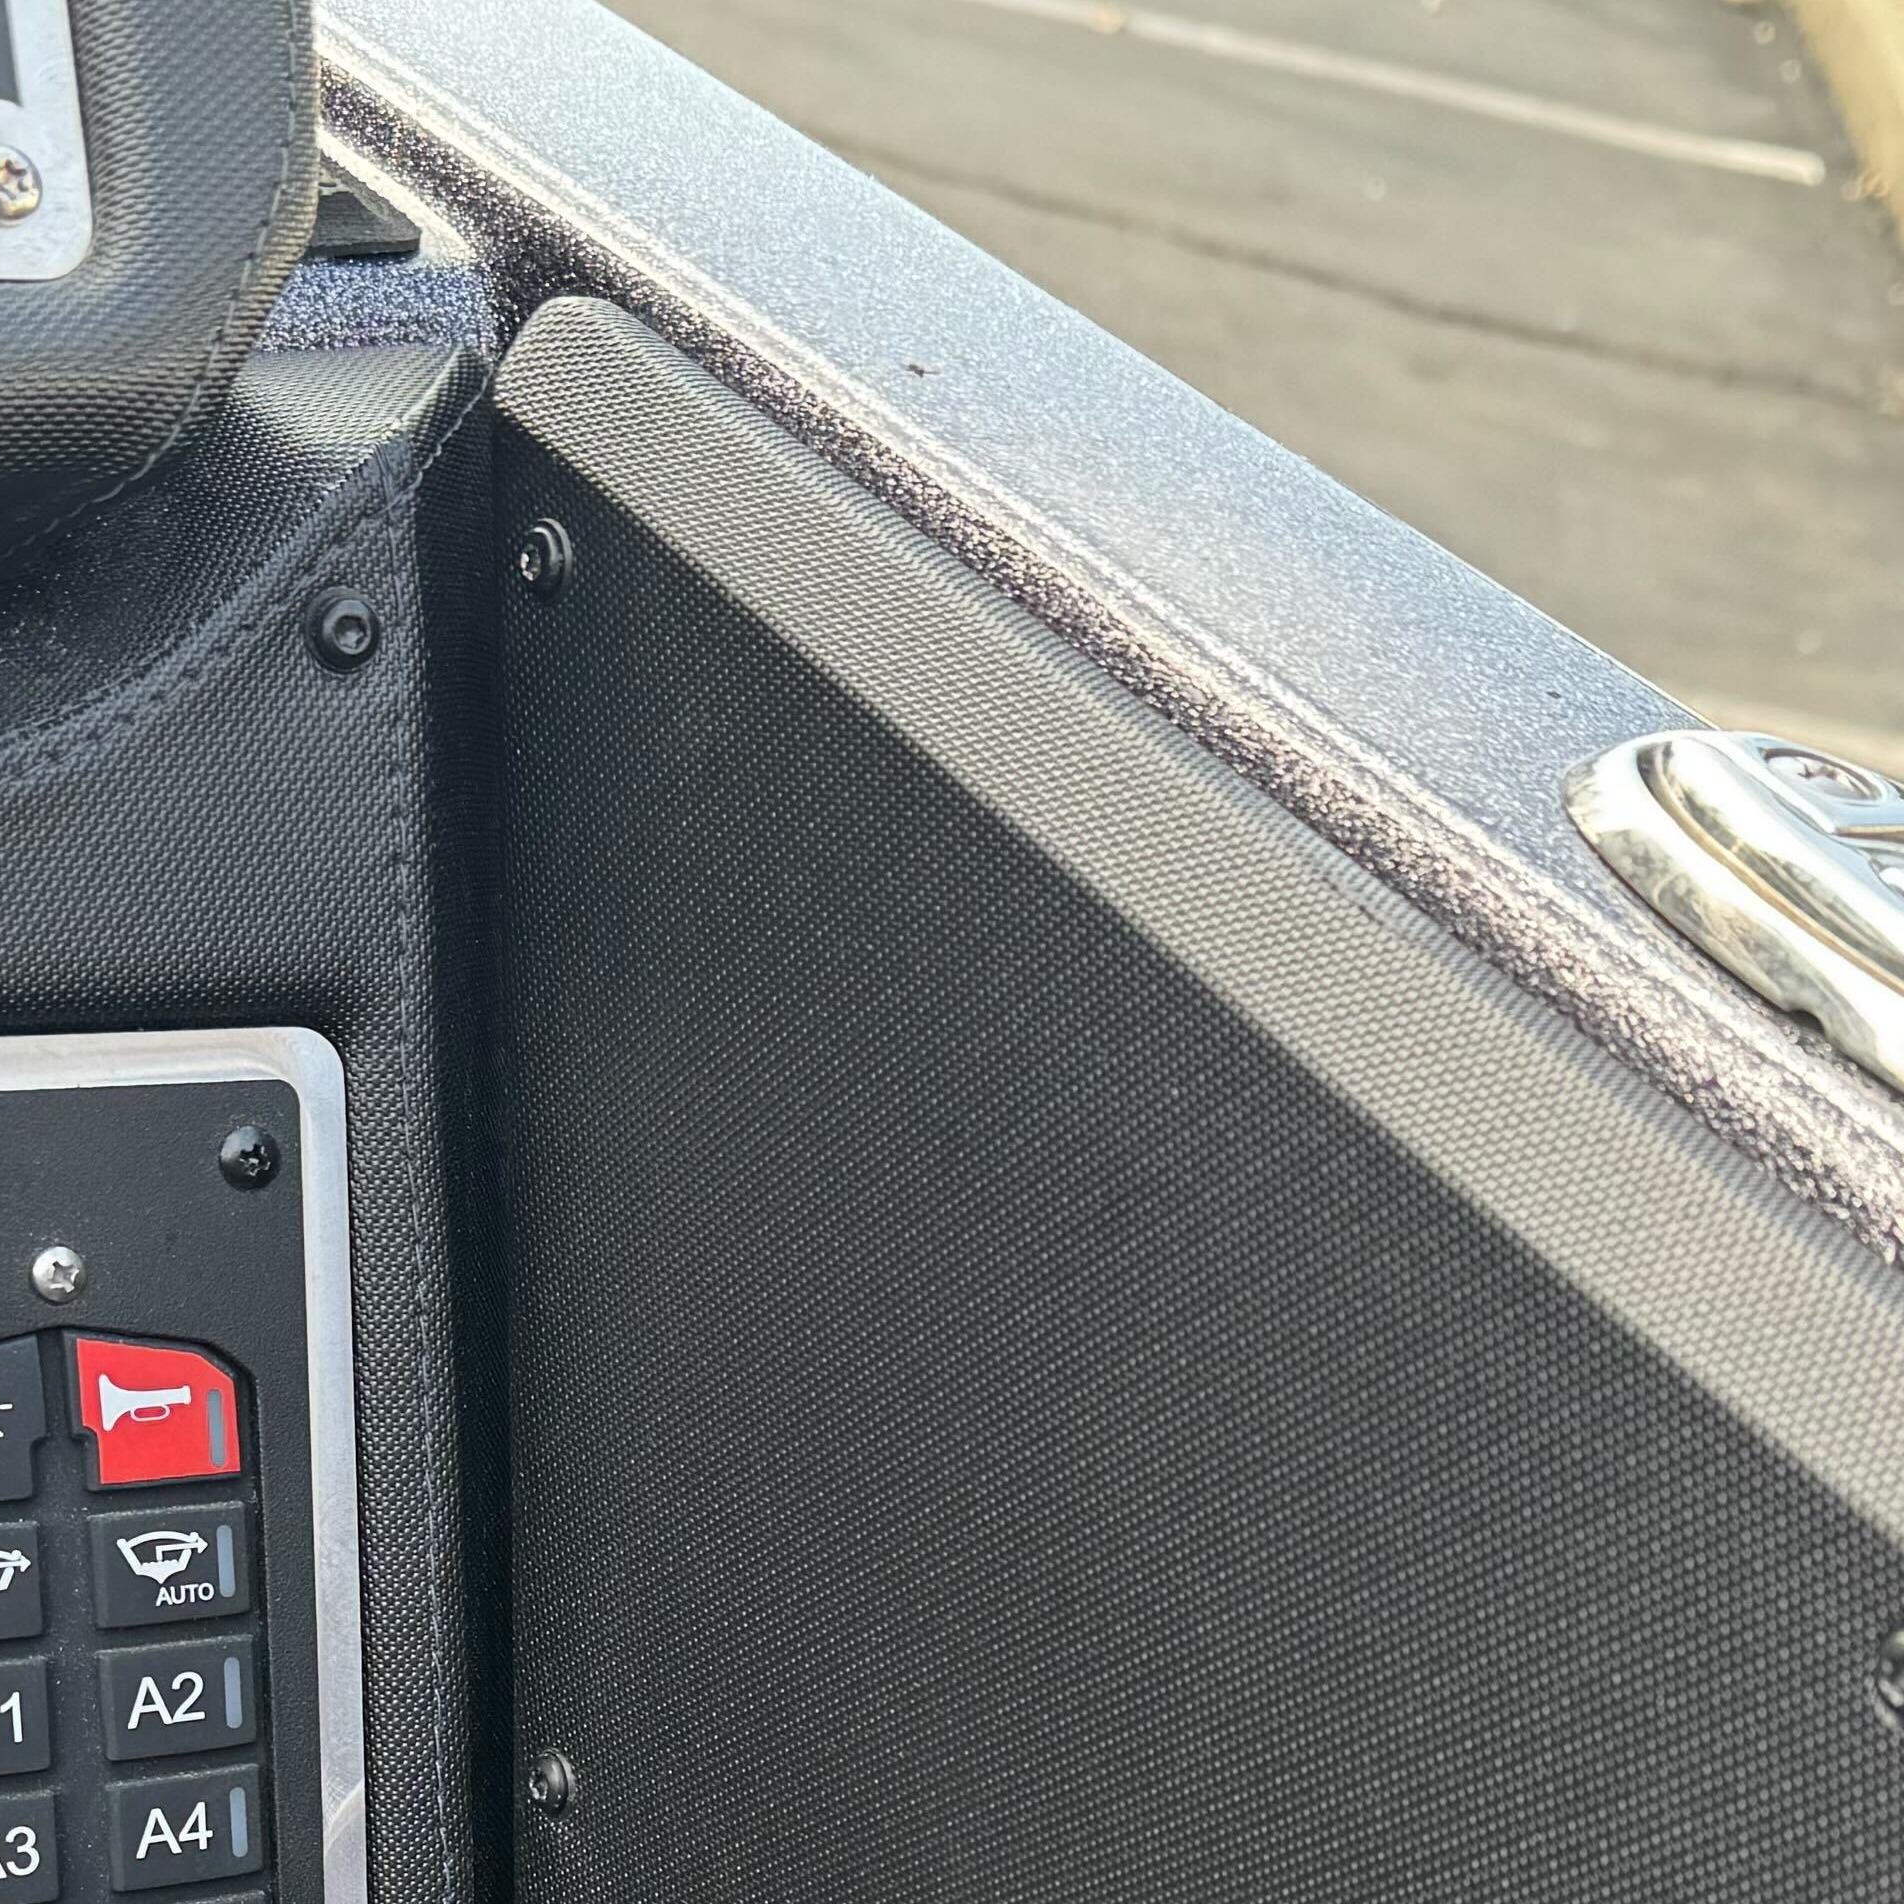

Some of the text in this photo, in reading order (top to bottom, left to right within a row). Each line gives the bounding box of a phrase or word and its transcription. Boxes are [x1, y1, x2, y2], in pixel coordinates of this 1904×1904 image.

[156, 1582, 214, 1606] AUTO
[127, 1671, 206, 1730] A2
[136, 1802, 214, 1859] A4
